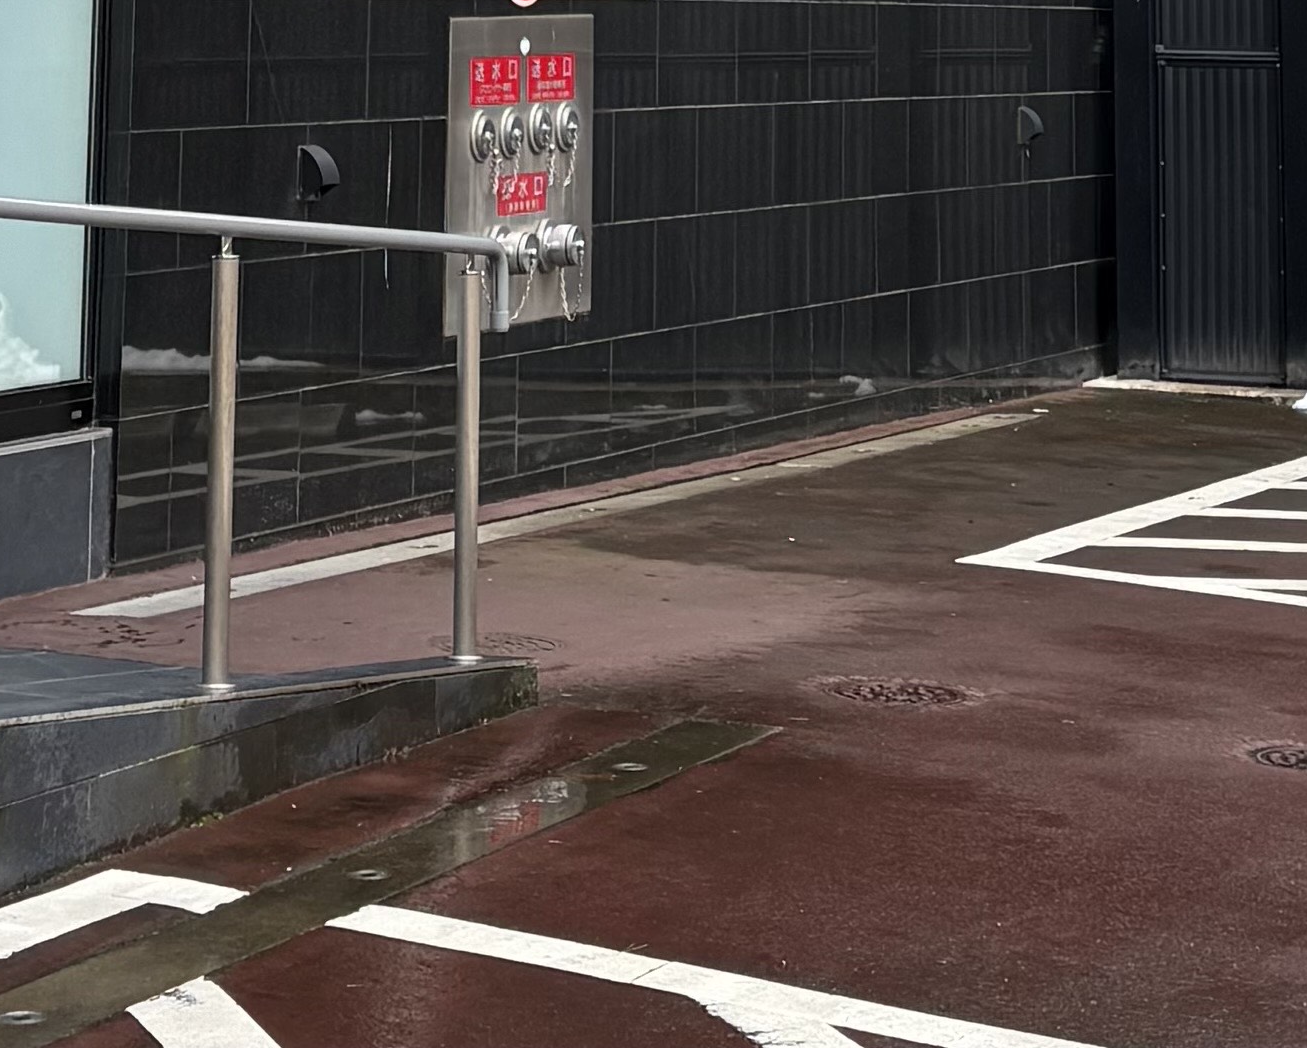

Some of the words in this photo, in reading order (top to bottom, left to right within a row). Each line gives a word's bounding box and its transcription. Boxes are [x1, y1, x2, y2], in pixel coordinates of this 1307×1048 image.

[474, 58, 518, 83] 送水口
[531, 56, 572, 79] 送水口
